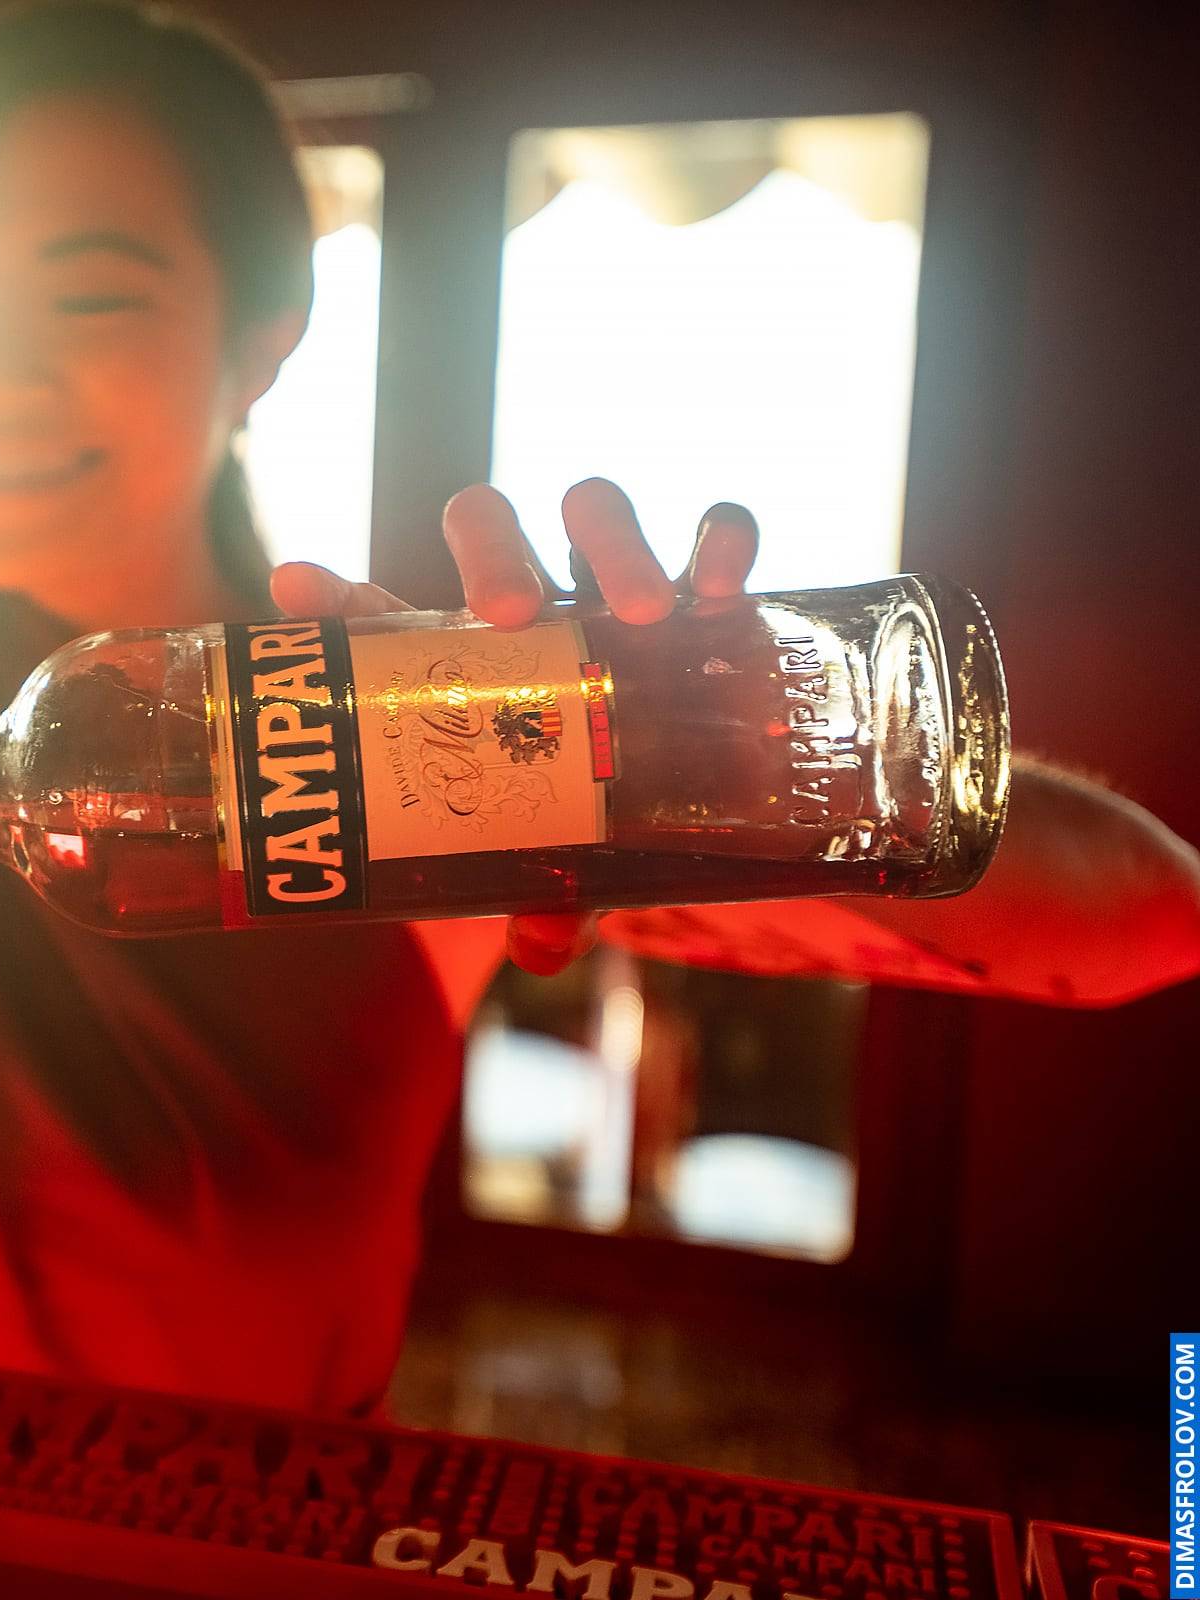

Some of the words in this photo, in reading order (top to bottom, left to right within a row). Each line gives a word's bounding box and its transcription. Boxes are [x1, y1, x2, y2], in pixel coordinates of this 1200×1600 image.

[247, 621, 347, 902] CAMPARI
[775, 636, 830, 828] CAMPARI
[371, 1526, 830, 1600] CAMP
[580, 1478, 935, 1565] CAMPARI
